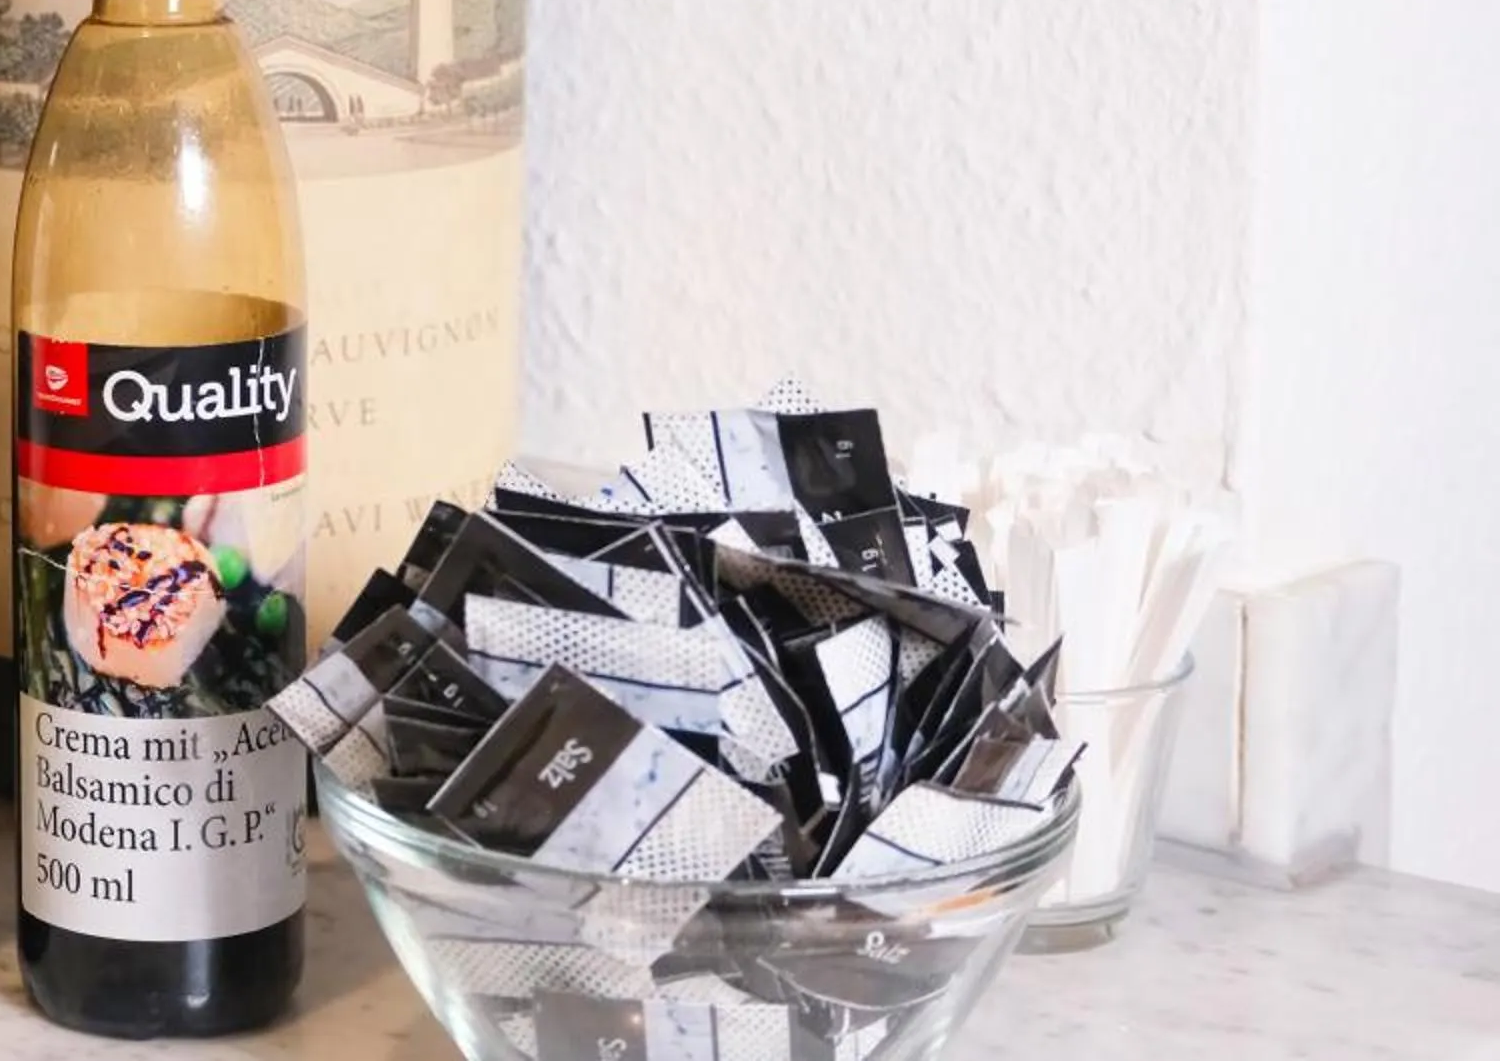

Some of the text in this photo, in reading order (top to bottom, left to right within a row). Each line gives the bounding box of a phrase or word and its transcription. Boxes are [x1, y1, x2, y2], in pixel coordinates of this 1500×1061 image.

[309, 305, 499, 367] AUVIGNON
[103, 365, 297, 422] Quality
[35, 712, 131, 760] Crema
[142, 728, 203, 762] mit
[536, 736, 594, 791] Salz
[35, 754, 237, 807] Balsamico di
[35, 798, 158, 851] Modena
[35, 853, 137, 902] 500 ml
